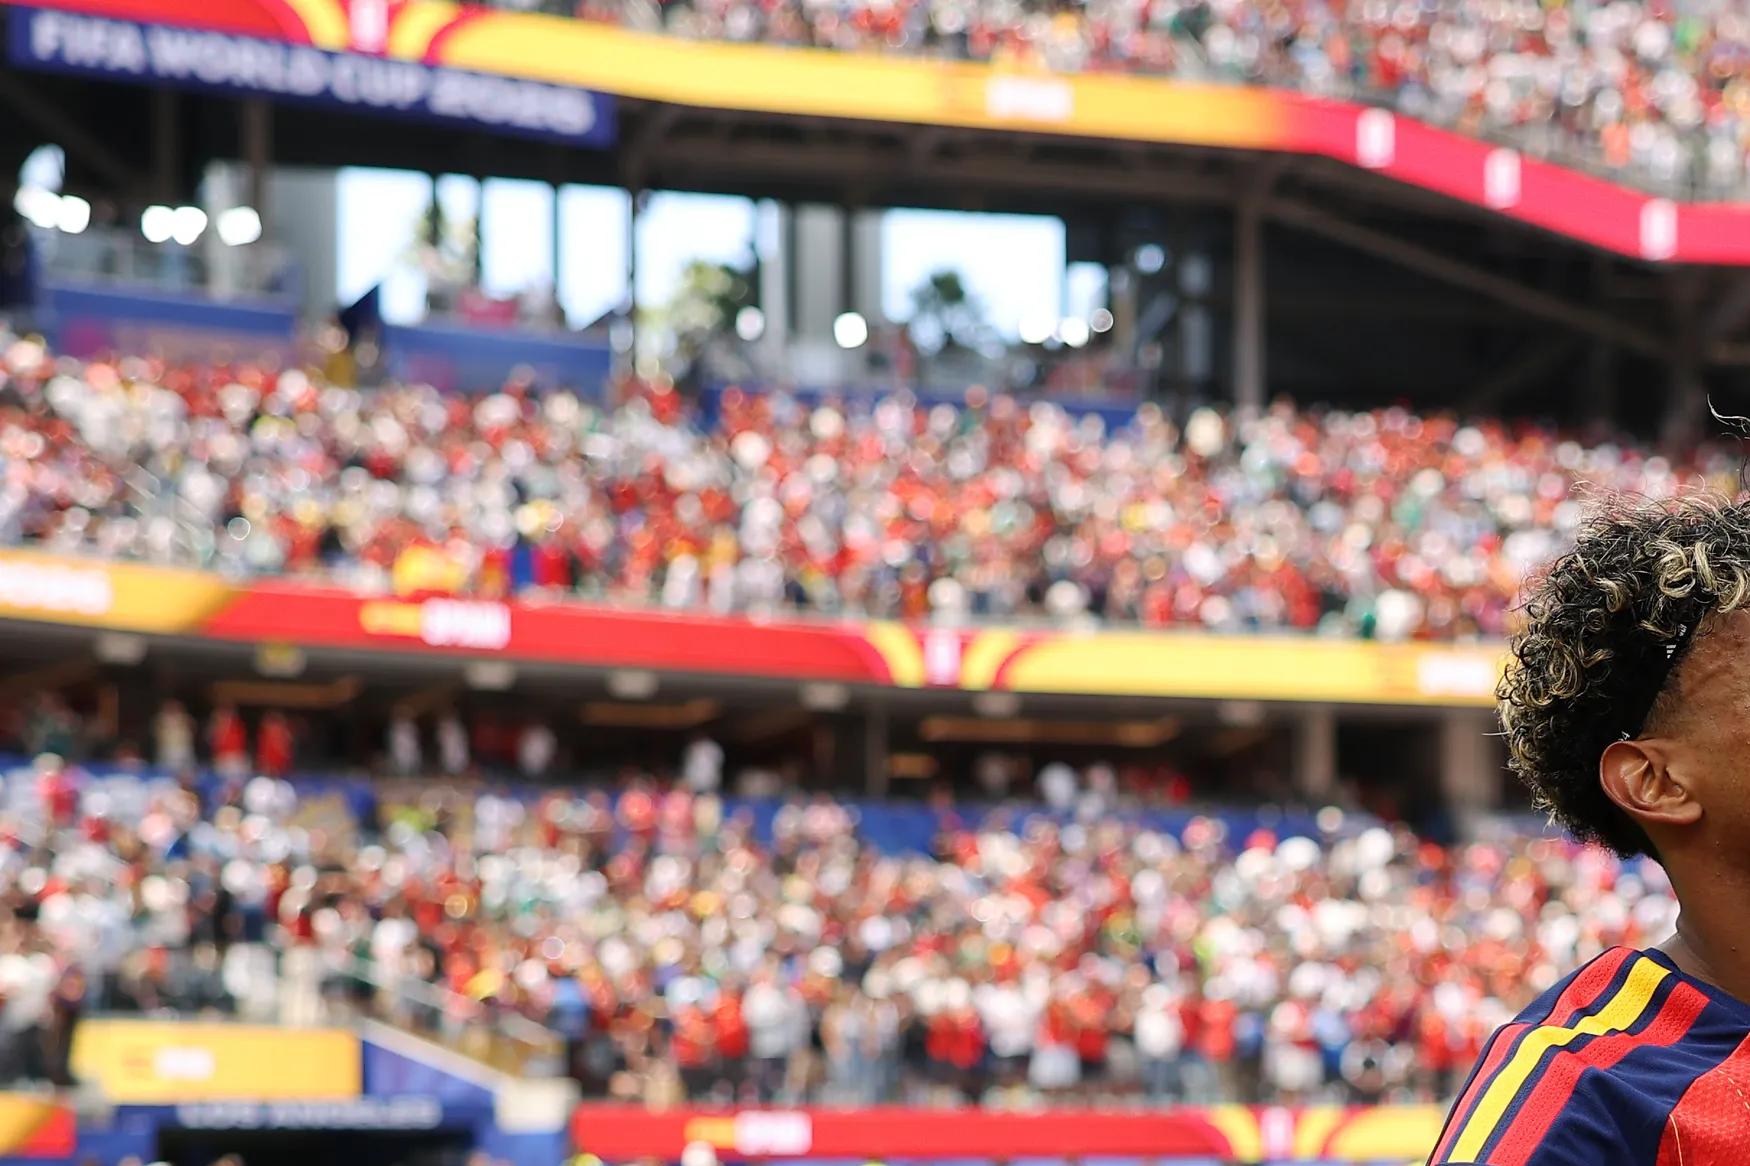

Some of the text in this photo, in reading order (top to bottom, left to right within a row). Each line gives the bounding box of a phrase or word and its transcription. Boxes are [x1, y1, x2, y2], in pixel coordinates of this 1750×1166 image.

[31, 10, 146, 73] FIFA
[149, 25, 328, 96] WORLD
[331, 54, 428, 109] CUP
